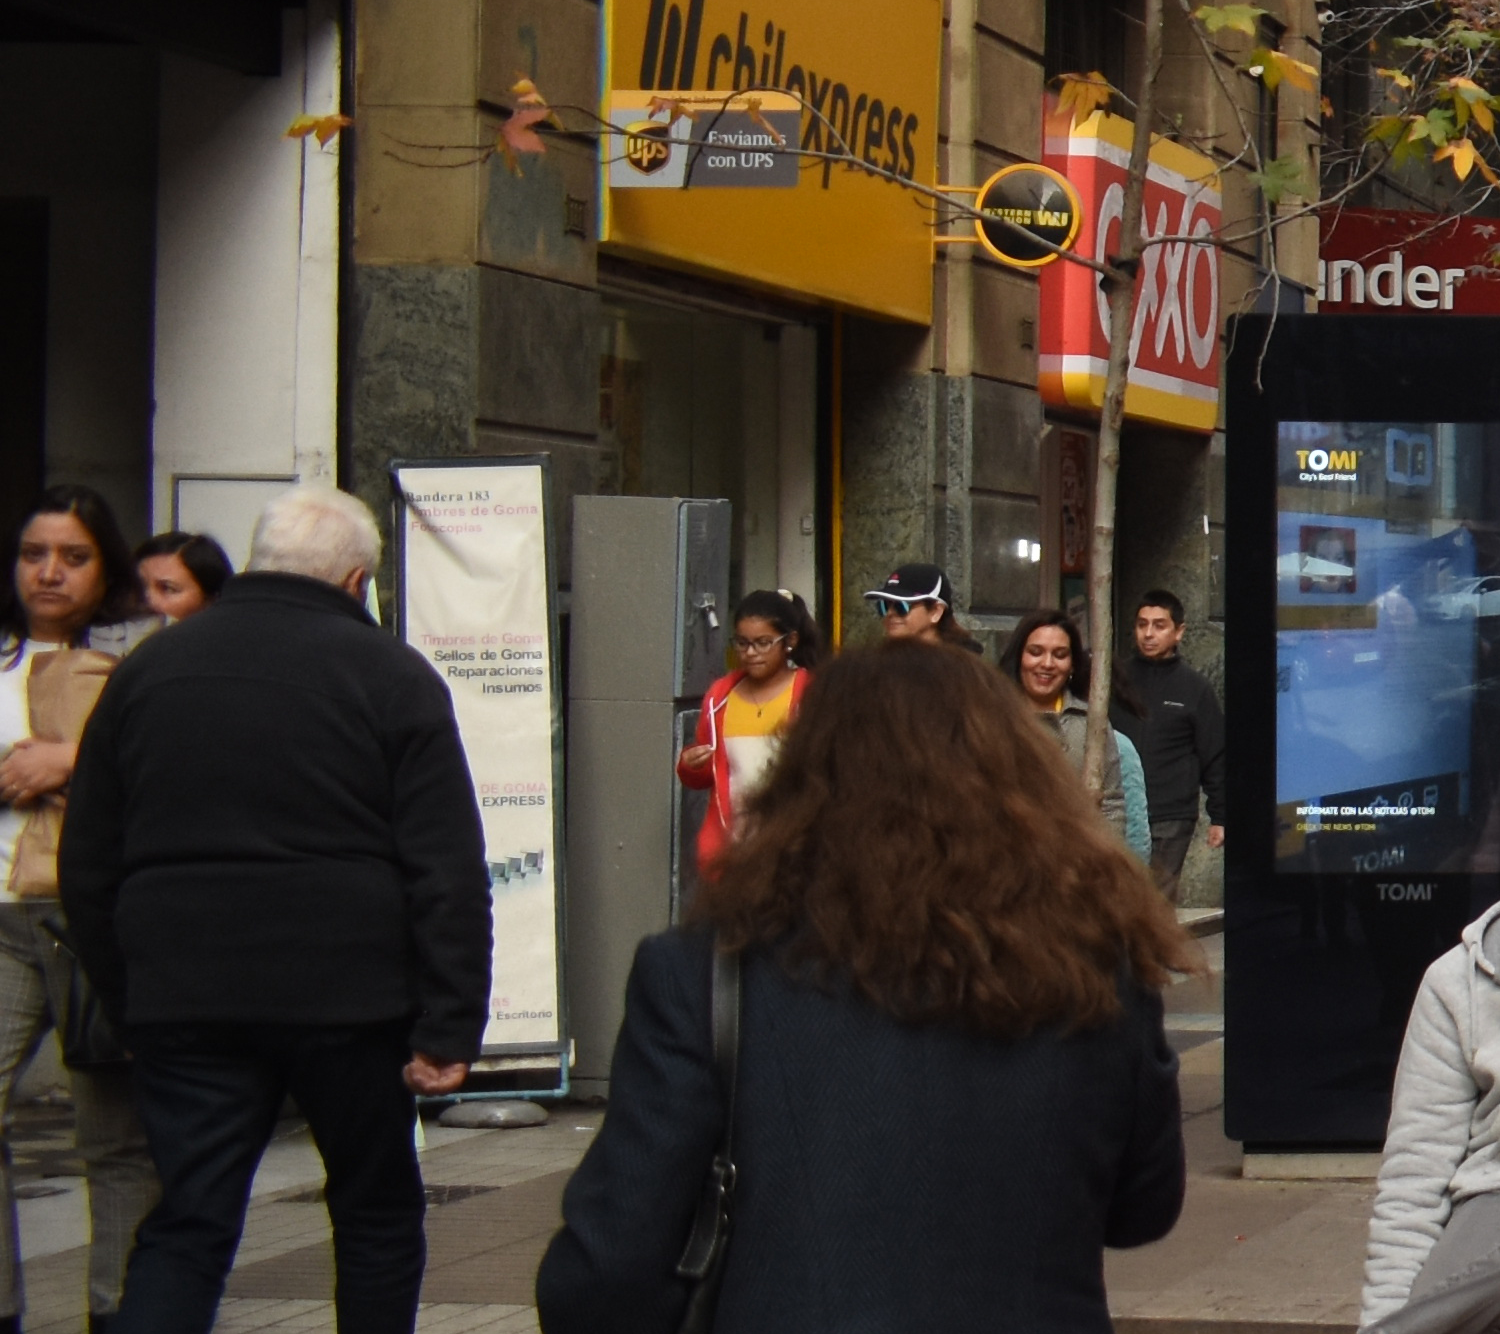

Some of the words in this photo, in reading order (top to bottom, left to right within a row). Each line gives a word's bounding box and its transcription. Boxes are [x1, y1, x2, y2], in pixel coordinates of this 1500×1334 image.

[708, 158, 736, 168] con
[740, 152, 774, 168] UPS
[1096, 182, 1219, 370] OXXO
[1296, 449, 1357, 472] TOMI
[406, 491, 464, 503] Bandera
[468, 490, 490, 502] 183
[412, 505, 467, 519] mbres
[470, 505, 489, 516] de
[493, 504, 539, 516] Goma
[421, 634, 476, 646] Timbres
[481, 633, 498, 645] de
[502, 632, 544, 645] Goma
[434, 649, 476, 662] Sellos
[480, 649, 497, 661] de
[501, 648, 543, 661] Goma
[447, 665, 544, 680] Reparaciones
[482, 682, 543, 695] Insumos
[480, 784, 498, 795] DE
[503, 783, 547, 795] GOMA
[482, 795, 546, 808] EXPRESS
[1358, 806, 1373, 816] LAS
[1376, 882, 1433, 901] TOMI
[496, 1010, 553, 1021] Escritorio
